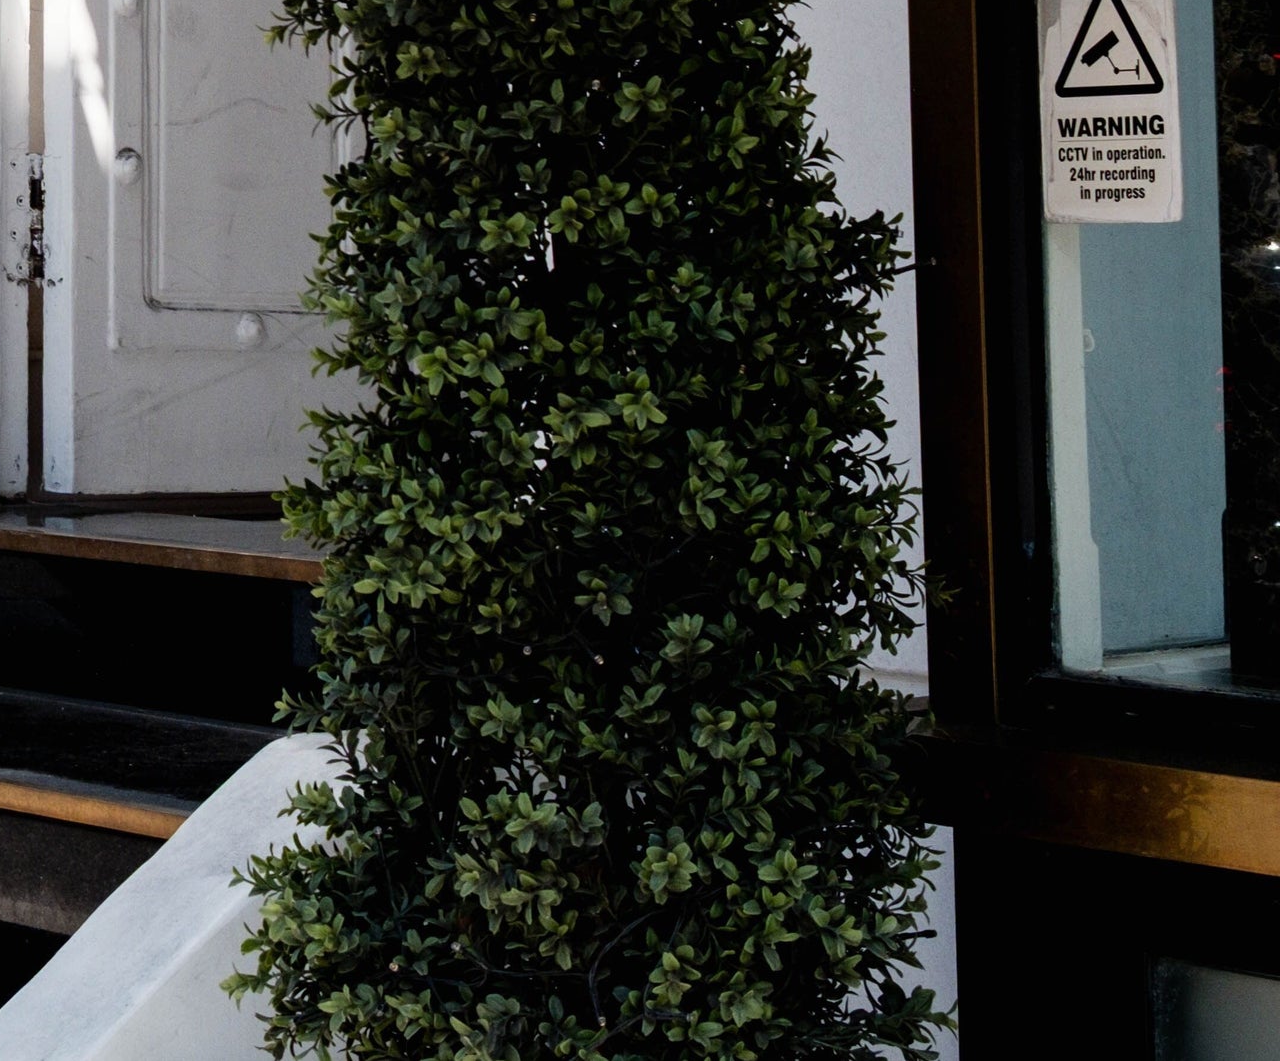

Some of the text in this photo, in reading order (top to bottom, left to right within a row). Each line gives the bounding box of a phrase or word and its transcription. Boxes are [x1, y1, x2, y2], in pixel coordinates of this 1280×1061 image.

[1057, 114, 1165, 138] WARNING
[1058, 146, 1166, 163] CCTV in operation.
[1070, 166, 1156, 184] 24hr recording
[1080, 186, 1146, 202] in progress
